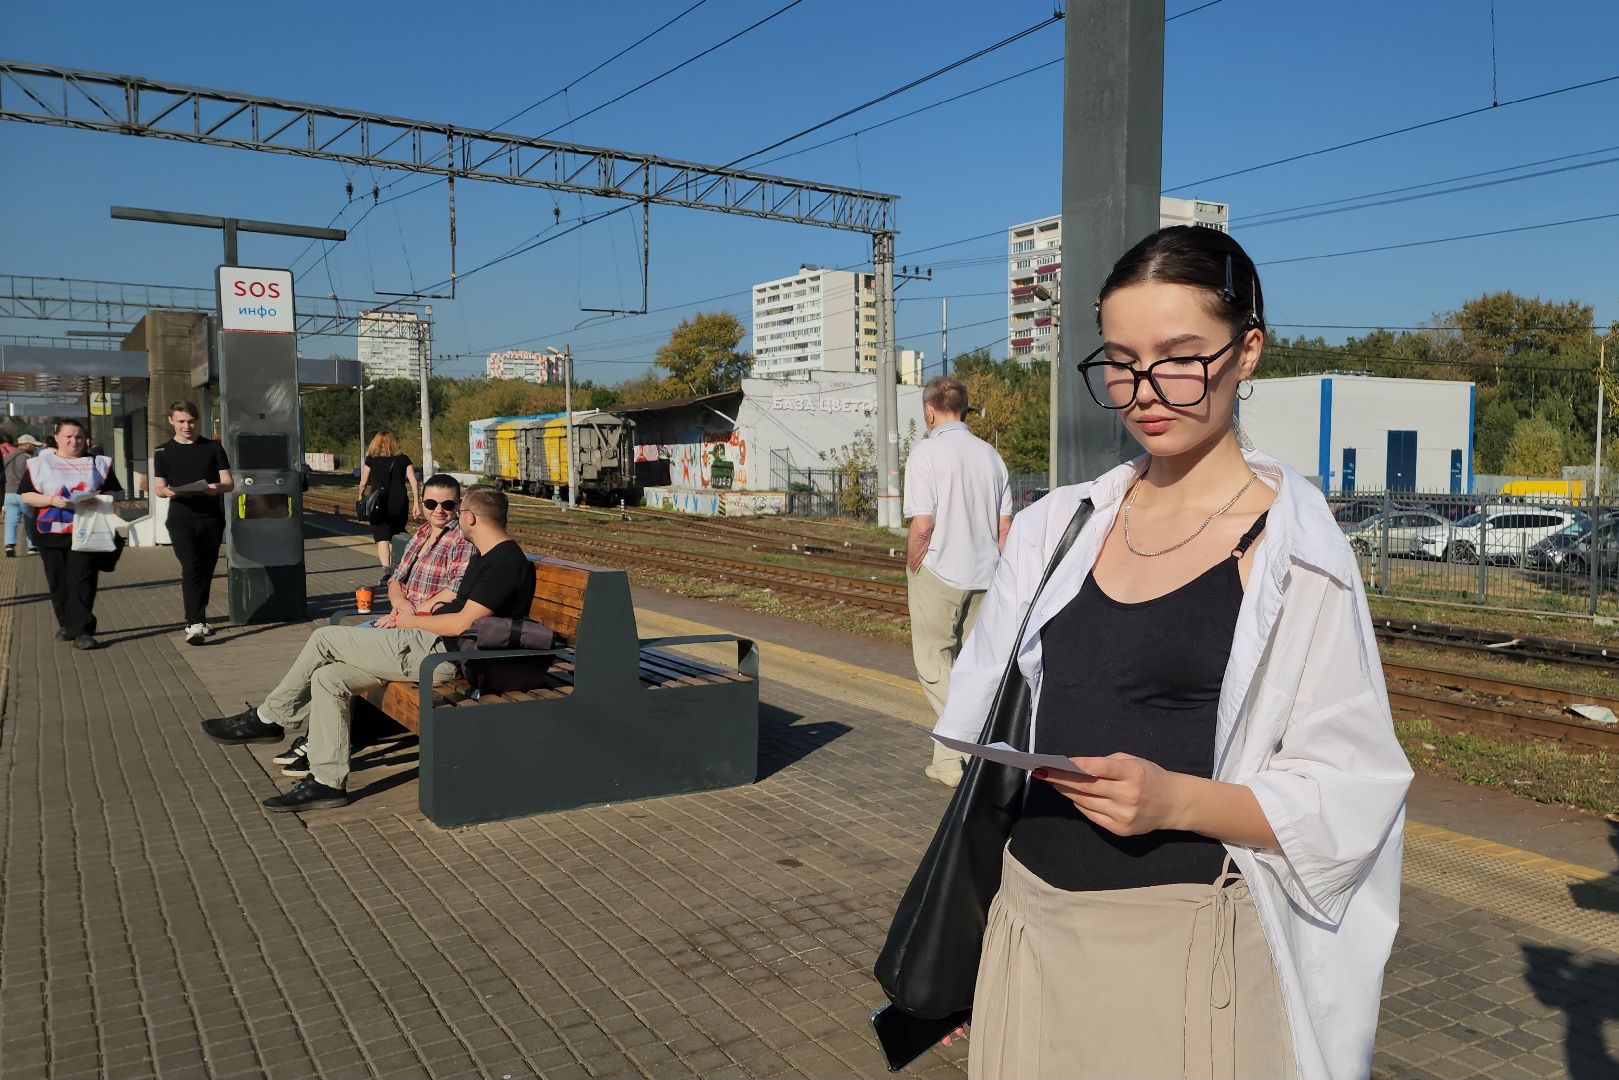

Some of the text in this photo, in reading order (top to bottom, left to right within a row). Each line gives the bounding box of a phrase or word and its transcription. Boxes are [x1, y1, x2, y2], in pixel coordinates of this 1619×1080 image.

[234, 280, 280, 298] SOS
[239, 305, 277, 318] инфо
[772, 398, 878, 414] БАЗА ЦВЕТО
